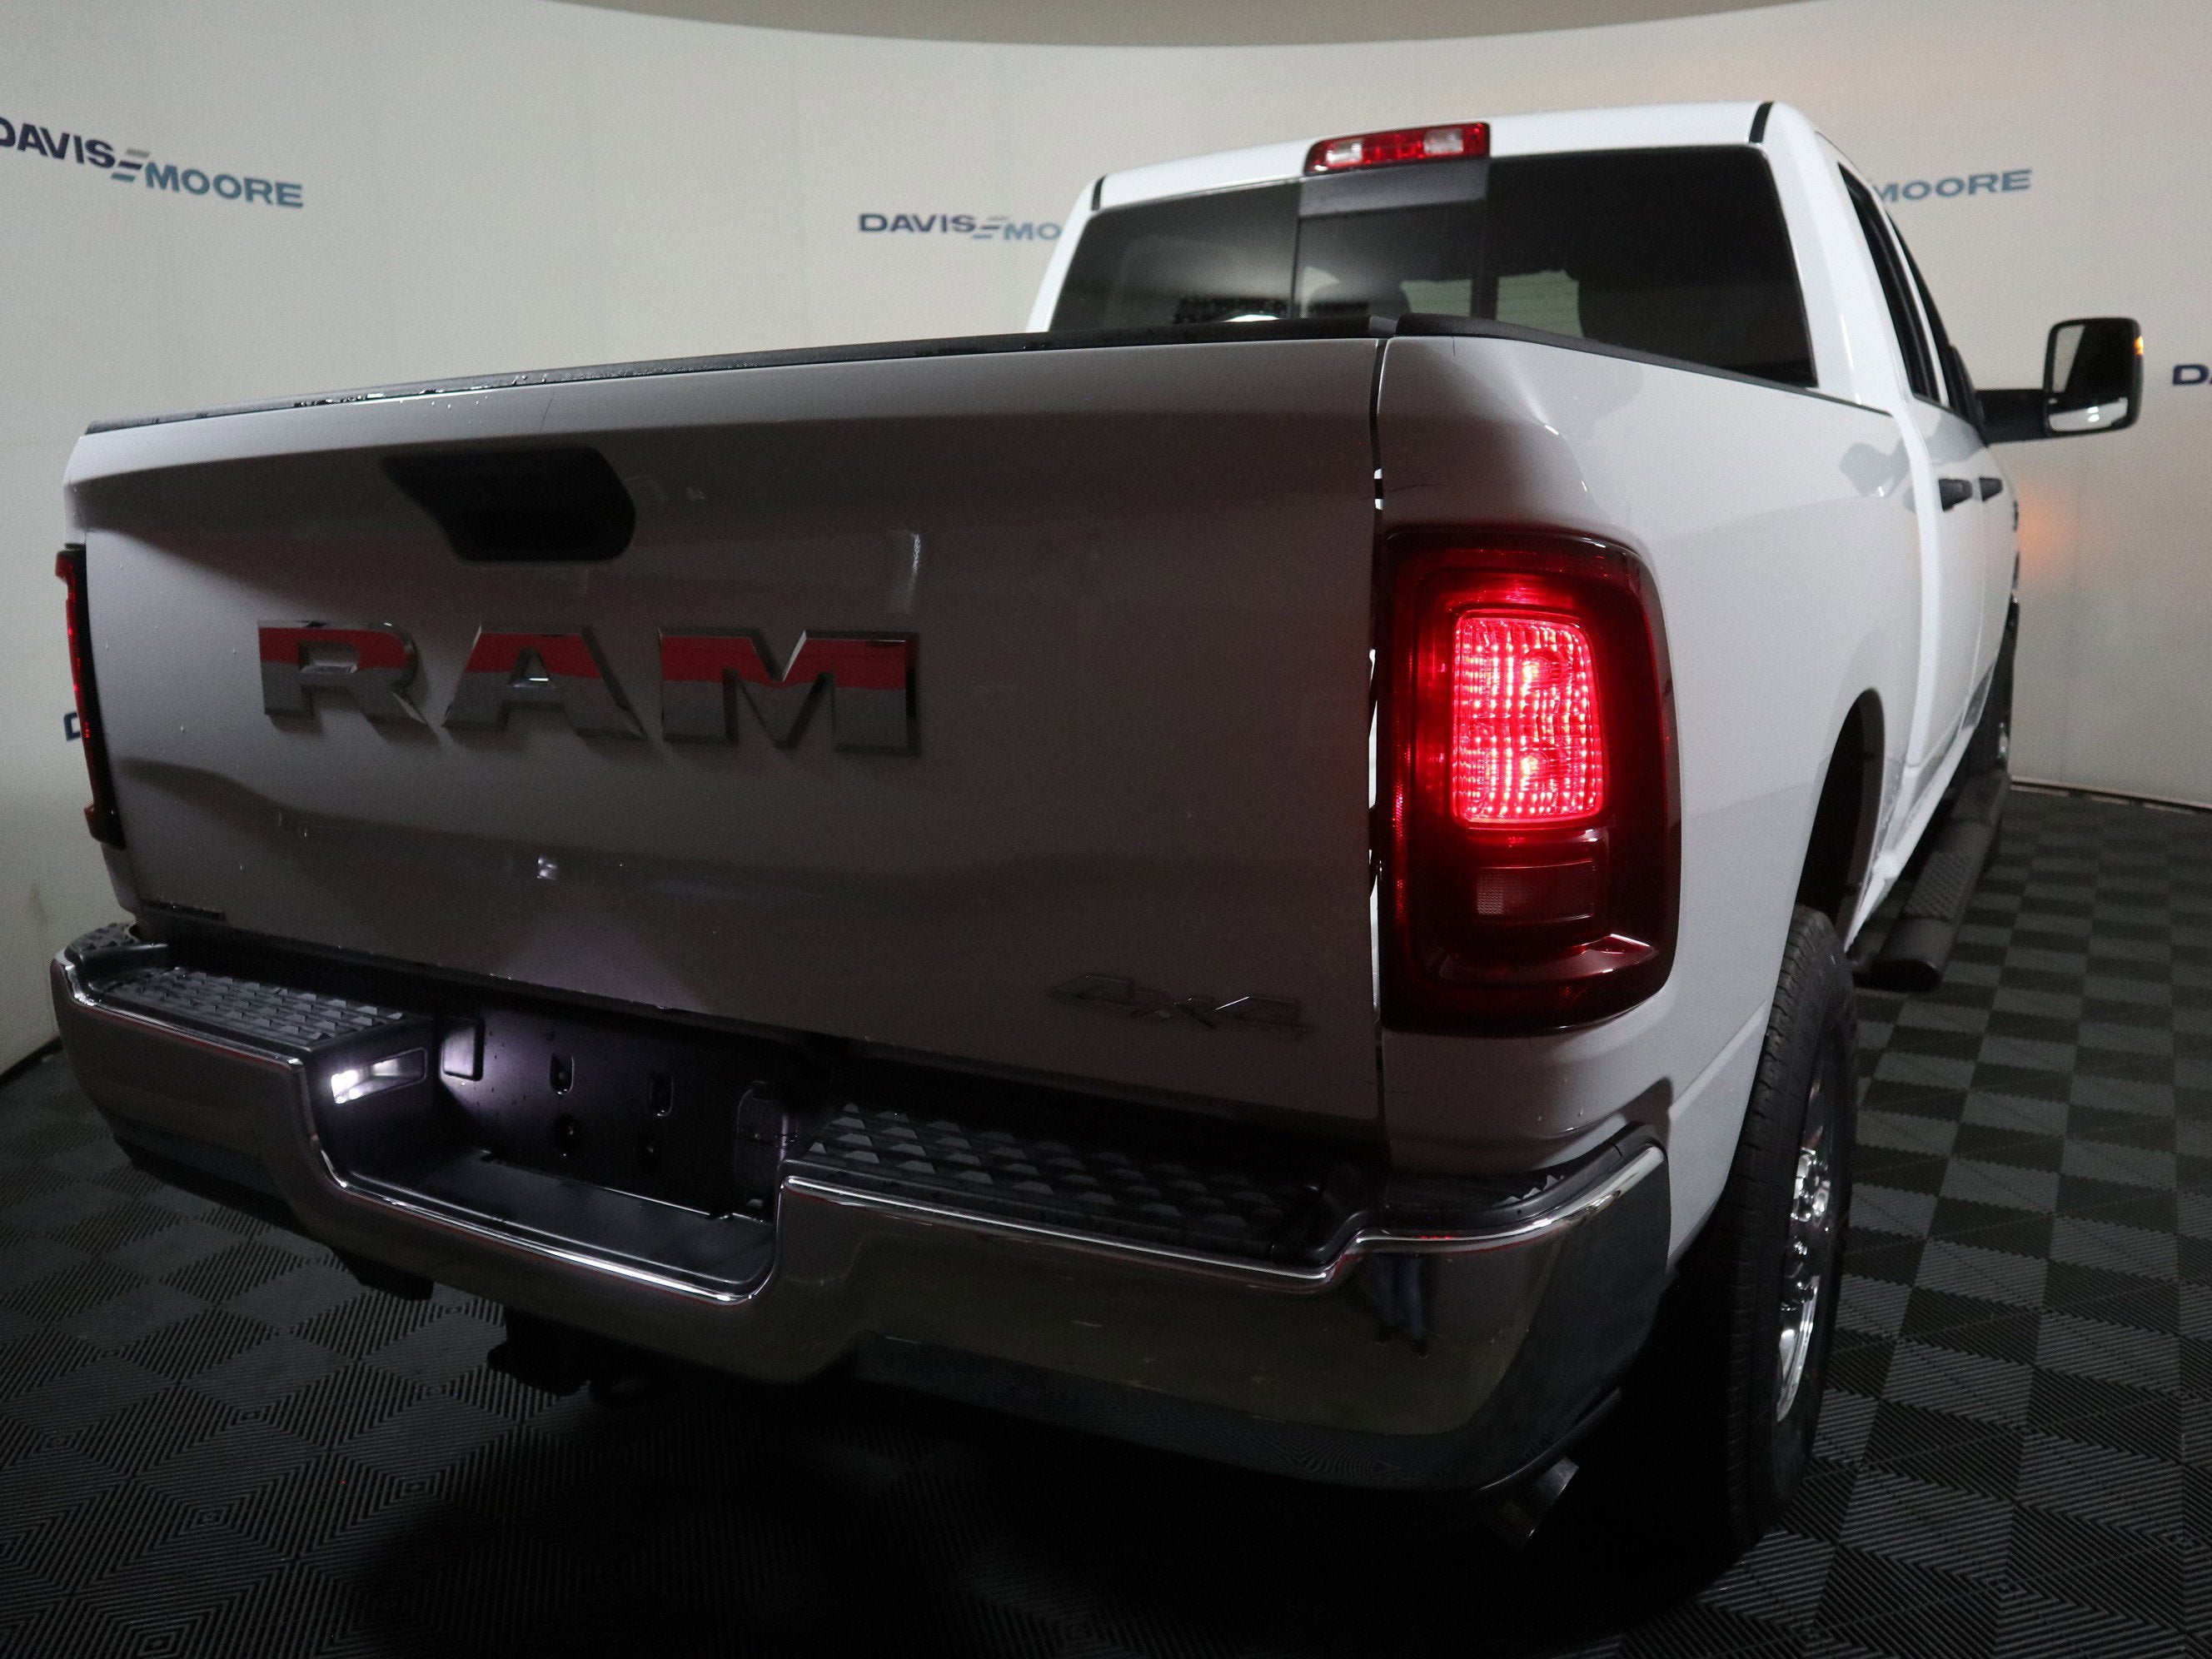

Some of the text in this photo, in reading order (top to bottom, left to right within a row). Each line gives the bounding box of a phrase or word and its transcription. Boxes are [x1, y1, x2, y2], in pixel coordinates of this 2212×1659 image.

[145, 162, 303, 208] MOORE
[859, 213, 975, 232] DAVIS
[258, 620, 919, 755] RAM
